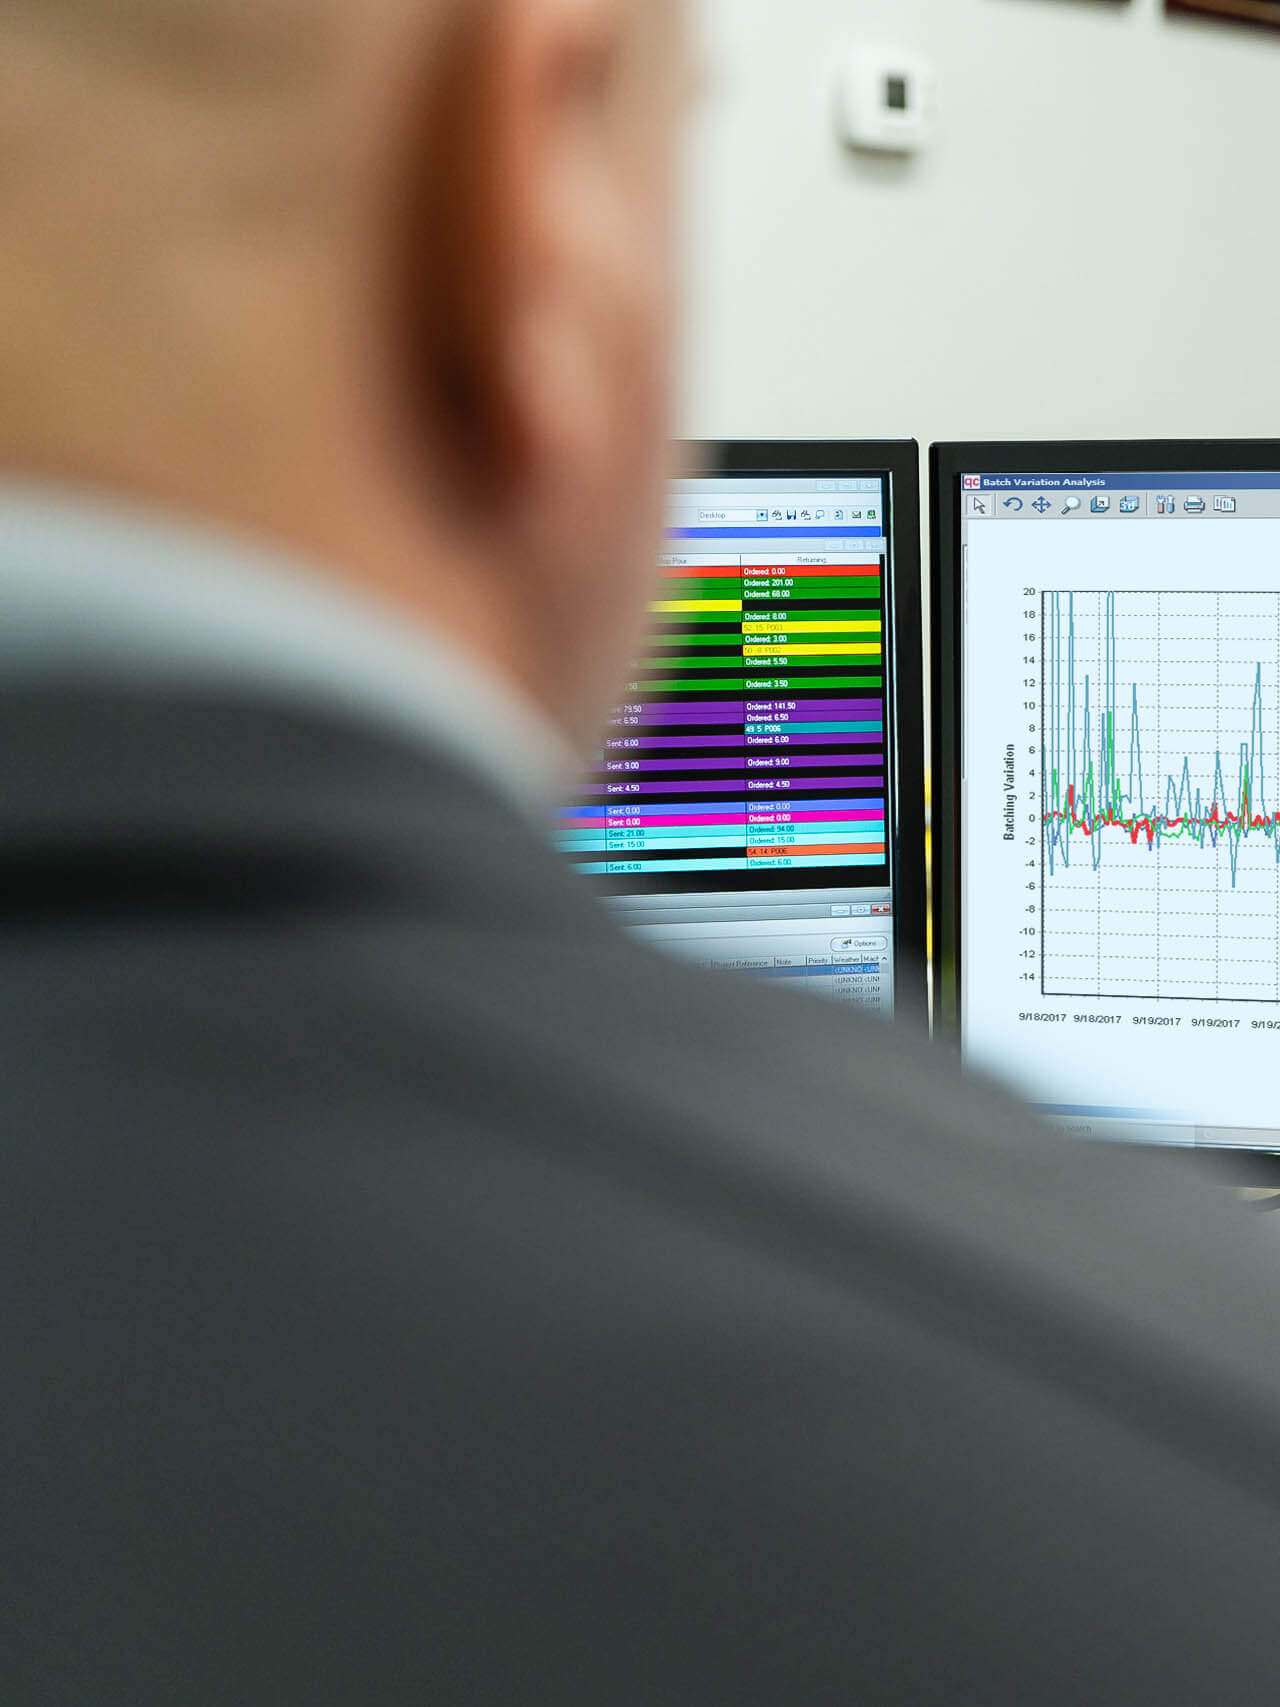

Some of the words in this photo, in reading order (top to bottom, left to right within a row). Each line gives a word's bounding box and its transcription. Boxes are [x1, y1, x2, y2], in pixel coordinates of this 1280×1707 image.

[983, 477, 1013, 488] Batch
[1013, 478, 1061, 488] Variation
[1062, 477, 1106, 488] Analysis
[1023, 587, 1036, 596] 20
[1023, 609, 1037, 619] 18
[1023, 633, 1036, 642] 16
[1023, 655, 1036, 665] 14
[1023, 678, 1036, 688] 12
[1023, 701, 1036, 711] 10
[1028, 723, 1036, 733] 8
[1003, 743, 1015, 790] Variation
[1028, 768, 1035, 777] 4
[1028, 791, 1036, 801] 2
[1002, 794, 1018, 841] Batching
[1028, 813, 1036, 823] 0
[1024, 836, 1036, 846] -2
[1025, 859, 1036, 868] -4
[1024, 881, 1036, 891] -6
[1024, 904, 1036, 914] -8
[1018, 927, 1036, 936] -10
[1018, 949, 1036, 959] -12
[1018, 972, 1035, 981] -14
[1018, 1012, 1067, 1023] 9/18/2017
[1073, 1014, 1122, 1024] 9/18/2017
[1132, 1016, 1182, 1026] 9/19/2017
[1191, 1018, 1241, 1028] 9/19/2017
